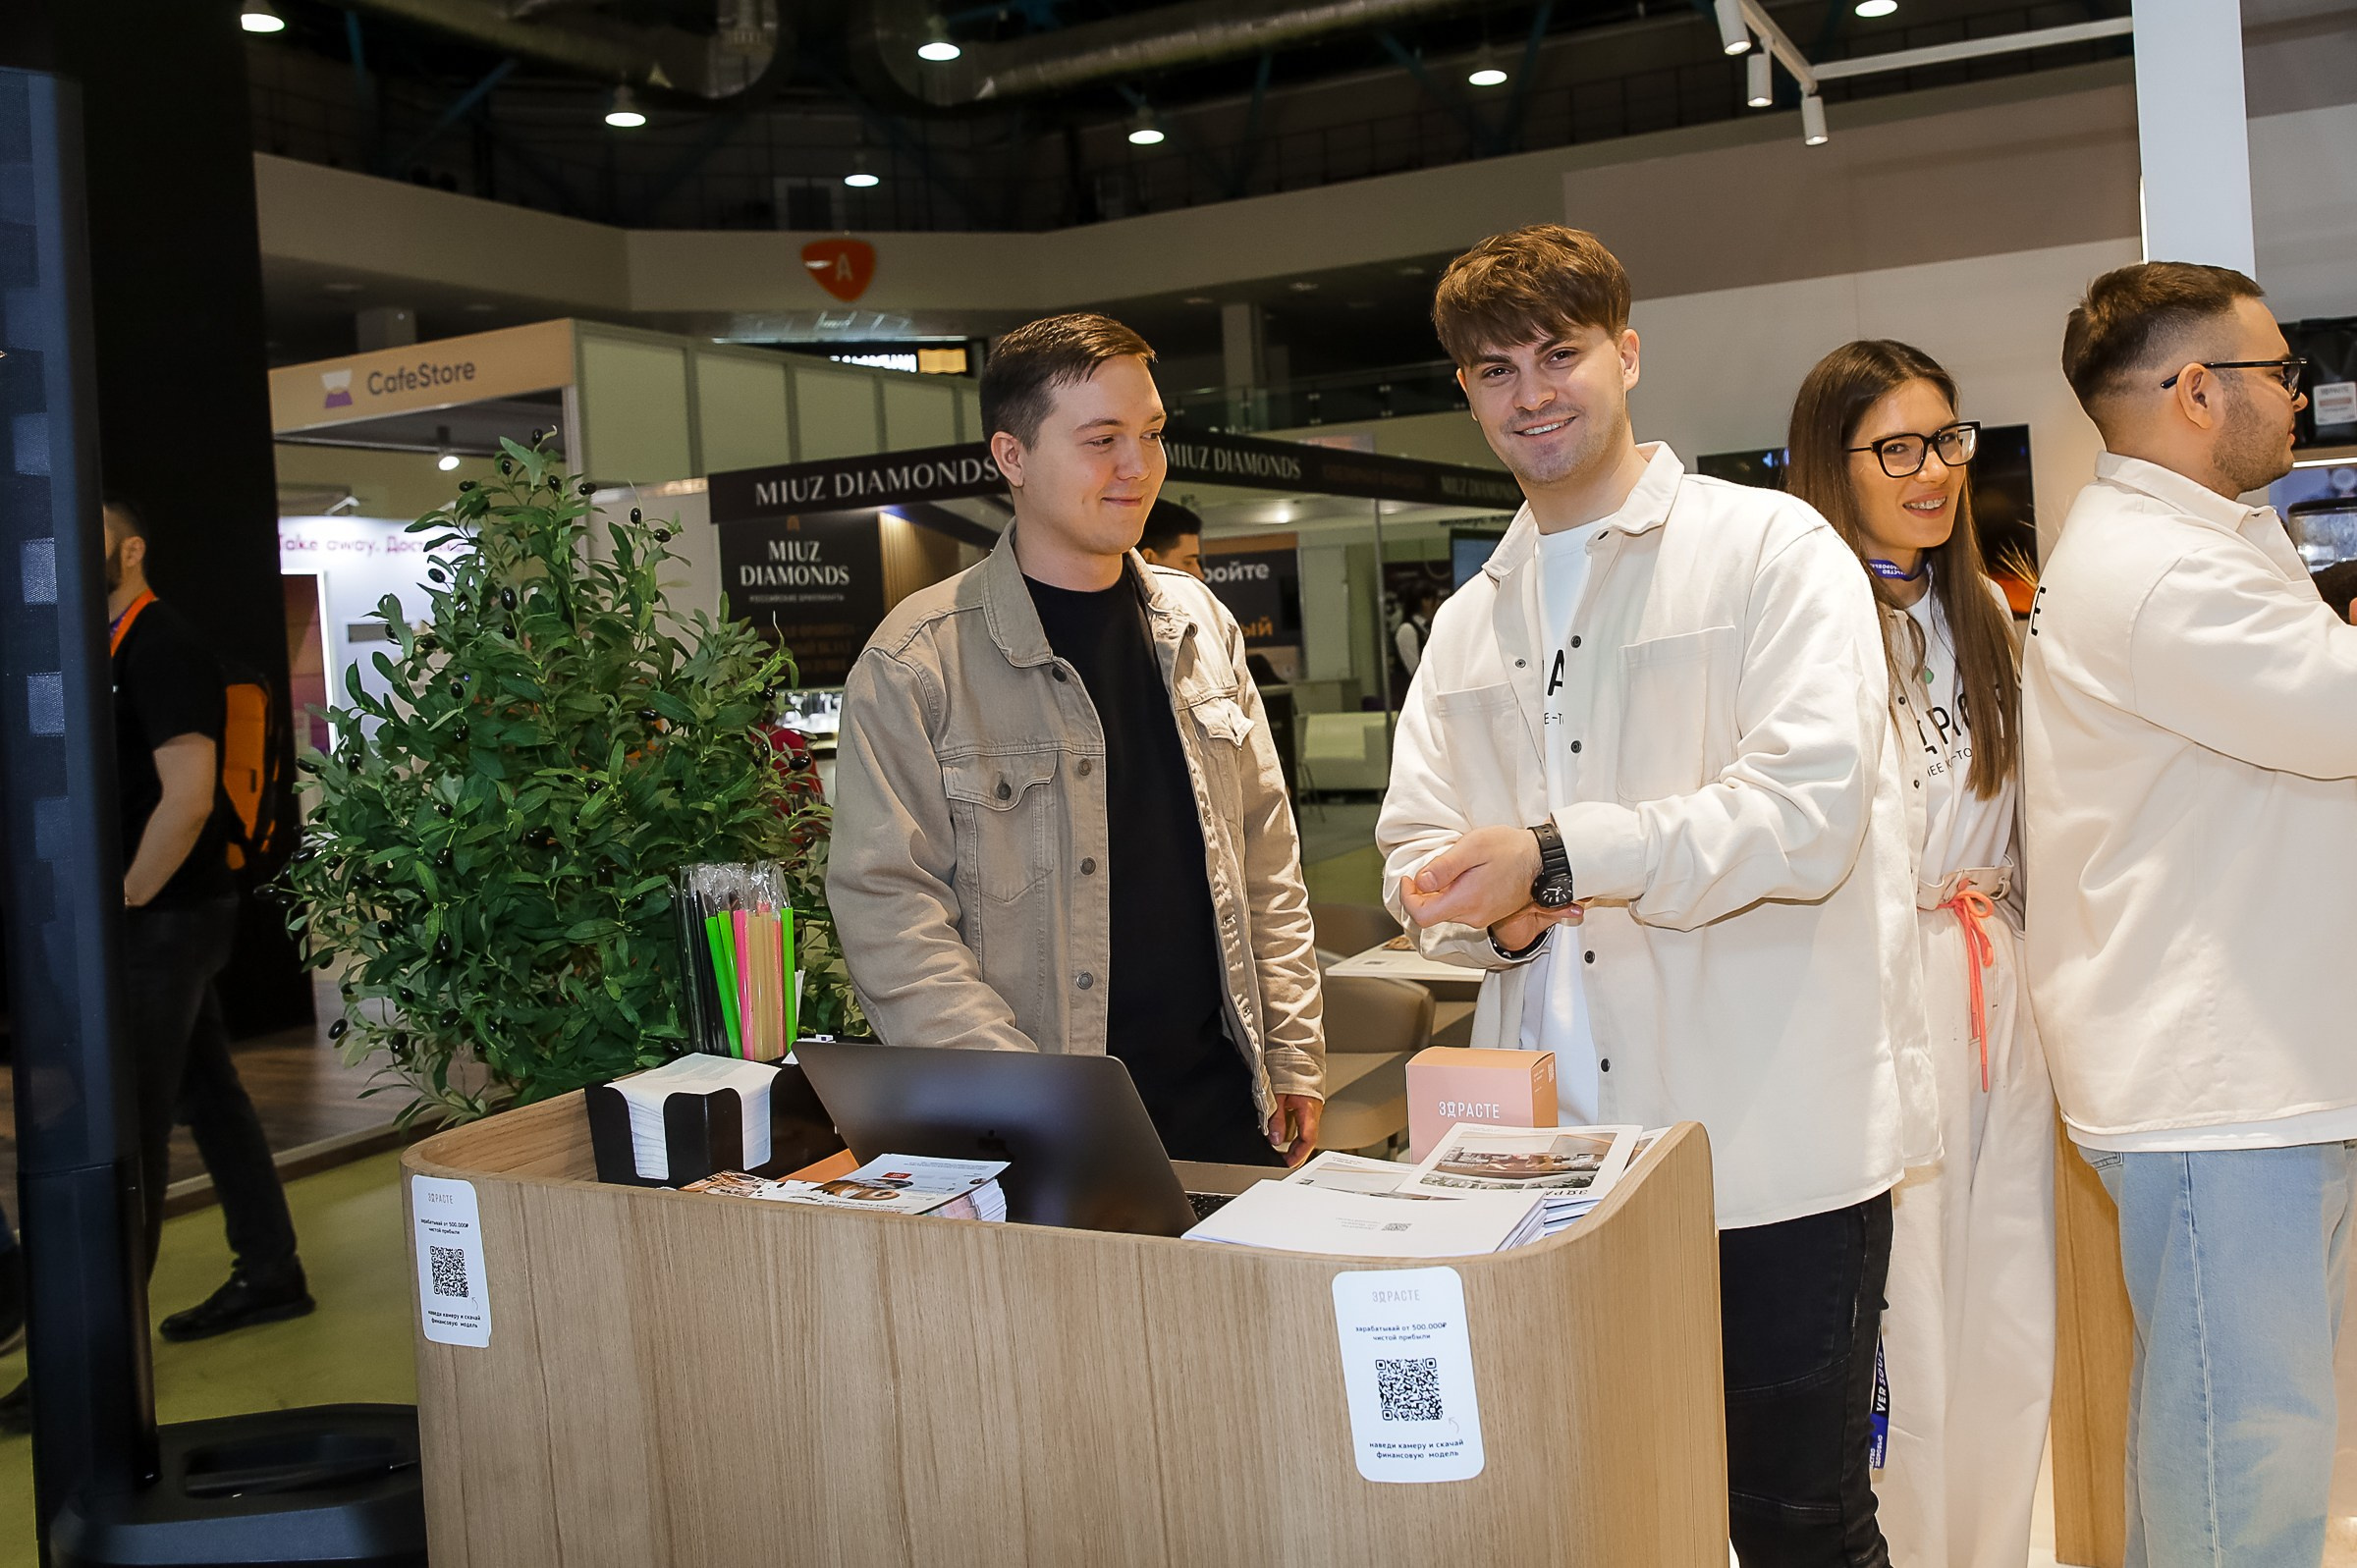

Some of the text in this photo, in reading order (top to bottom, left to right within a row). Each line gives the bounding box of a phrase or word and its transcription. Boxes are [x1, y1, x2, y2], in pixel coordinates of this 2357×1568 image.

[367, 361, 475, 396] CafeStore
[1214, 448, 1302, 480] DIAMONDS
[755, 458, 1000, 507] MIUZ DIAMONDS
[768, 541, 822, 563] MIUZ
[740, 565, 850, 587] DIAMONDS
[1355, 1324, 1400, 1333] зарабатывай
[1398, 1333, 1431, 1342] прибыли
[1436, 1438, 1464, 1448] скачай
[1376, 1449, 1459, 1460] финансовую модель
